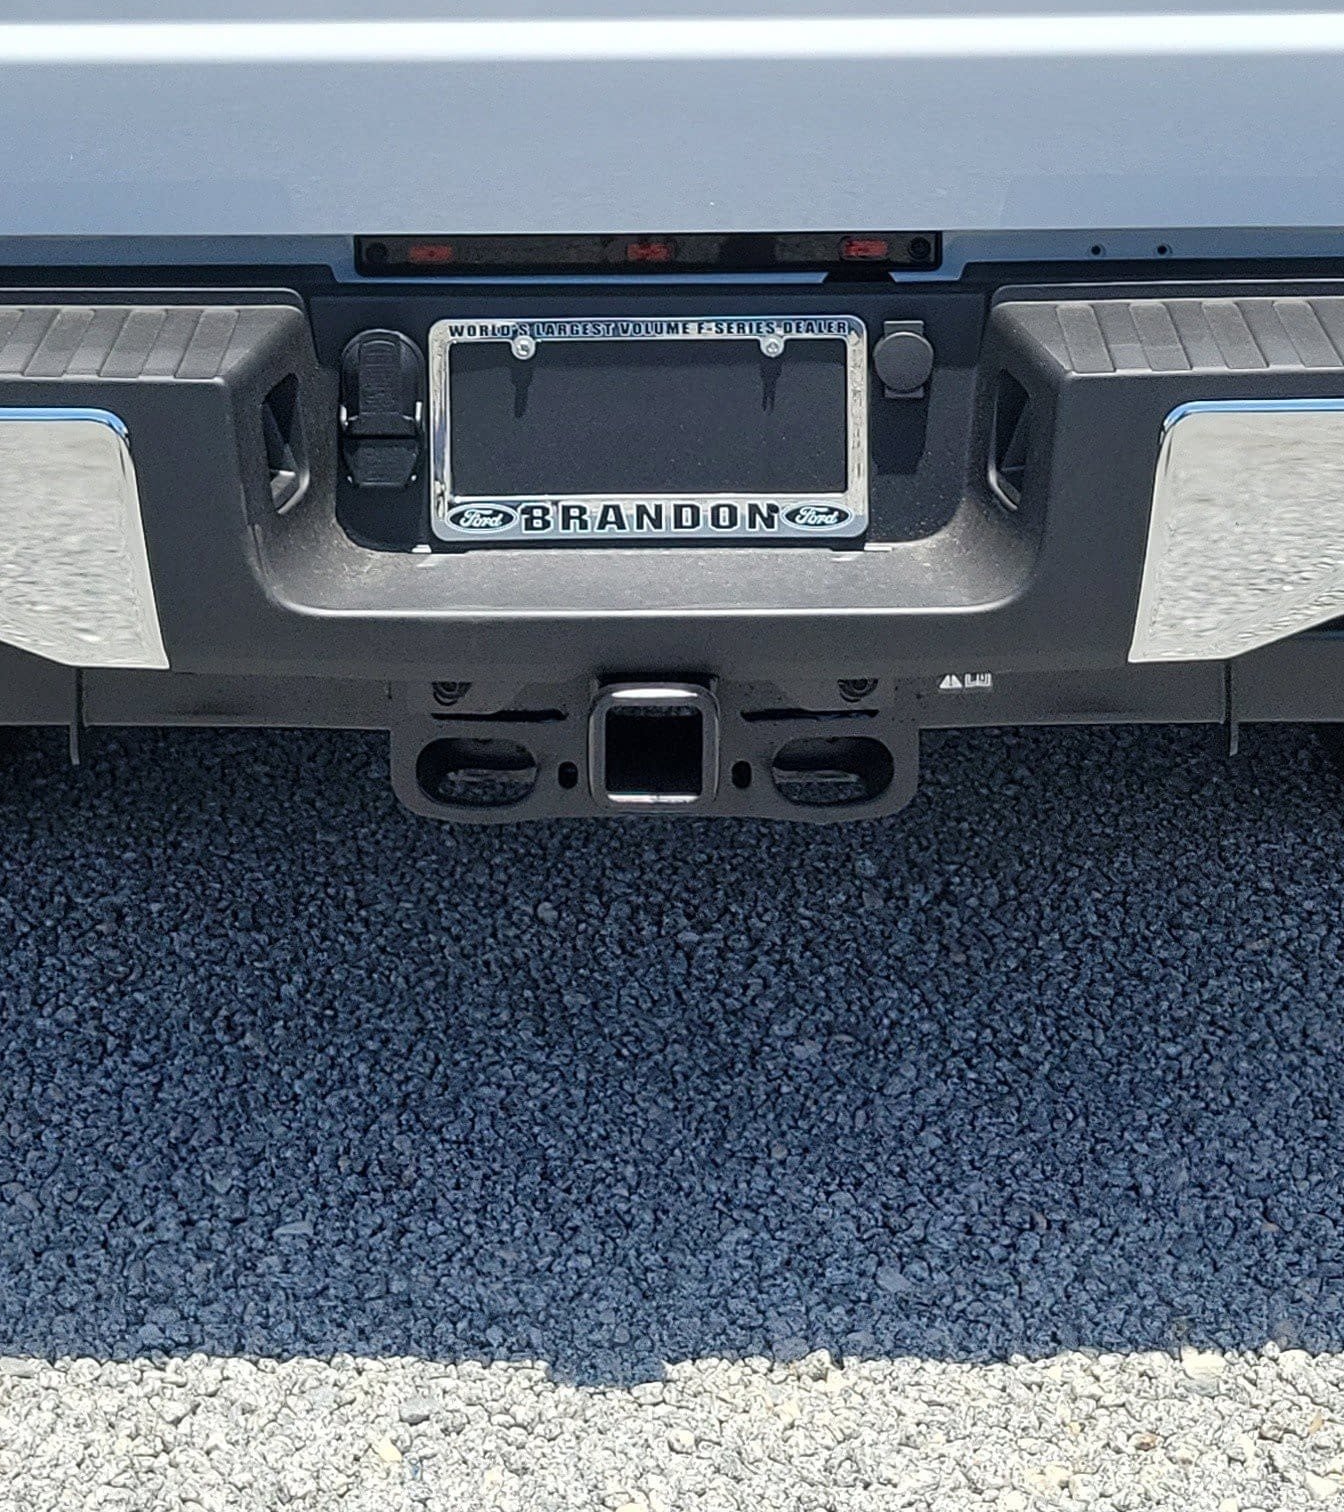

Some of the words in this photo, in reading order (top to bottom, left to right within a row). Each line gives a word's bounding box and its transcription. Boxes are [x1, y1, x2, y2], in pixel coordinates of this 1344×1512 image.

[449, 324, 529, 337] WORLD'S
[536, 322, 615, 336] LARGEST
[619, 321, 690, 335] VOLUME
[697, 320, 776, 335] F-SERIES
[783, 320, 846, 335] DEALER
[459, 508, 504, 528] Ford
[522, 503, 780, 532] BRANDON
[794, 505, 839, 524] Ford
